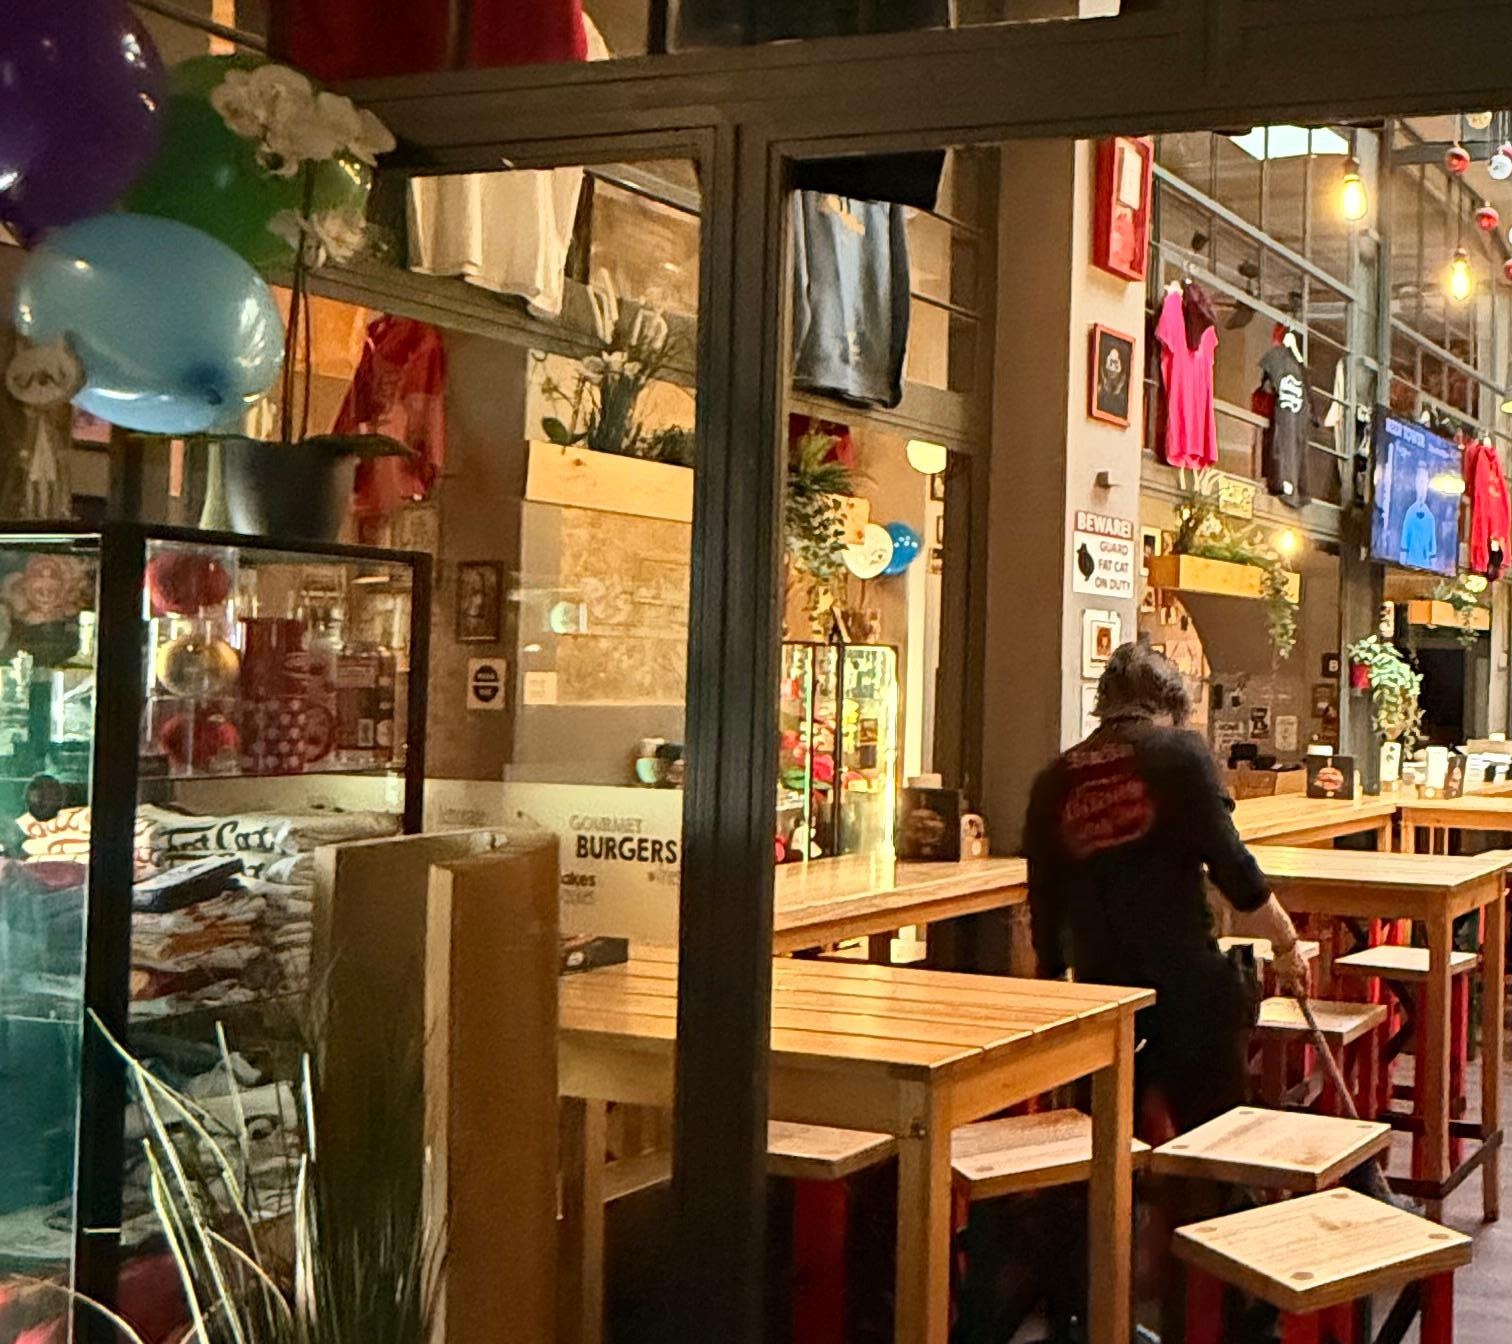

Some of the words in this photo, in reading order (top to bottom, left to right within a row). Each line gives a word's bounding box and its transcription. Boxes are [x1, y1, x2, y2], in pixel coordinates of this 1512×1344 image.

[1098, 558, 1113, 571] FAT
[1114, 561, 1129, 573] CAT
[576, 834, 678, 864] BURGERS
[560, 871, 596, 887] akes
